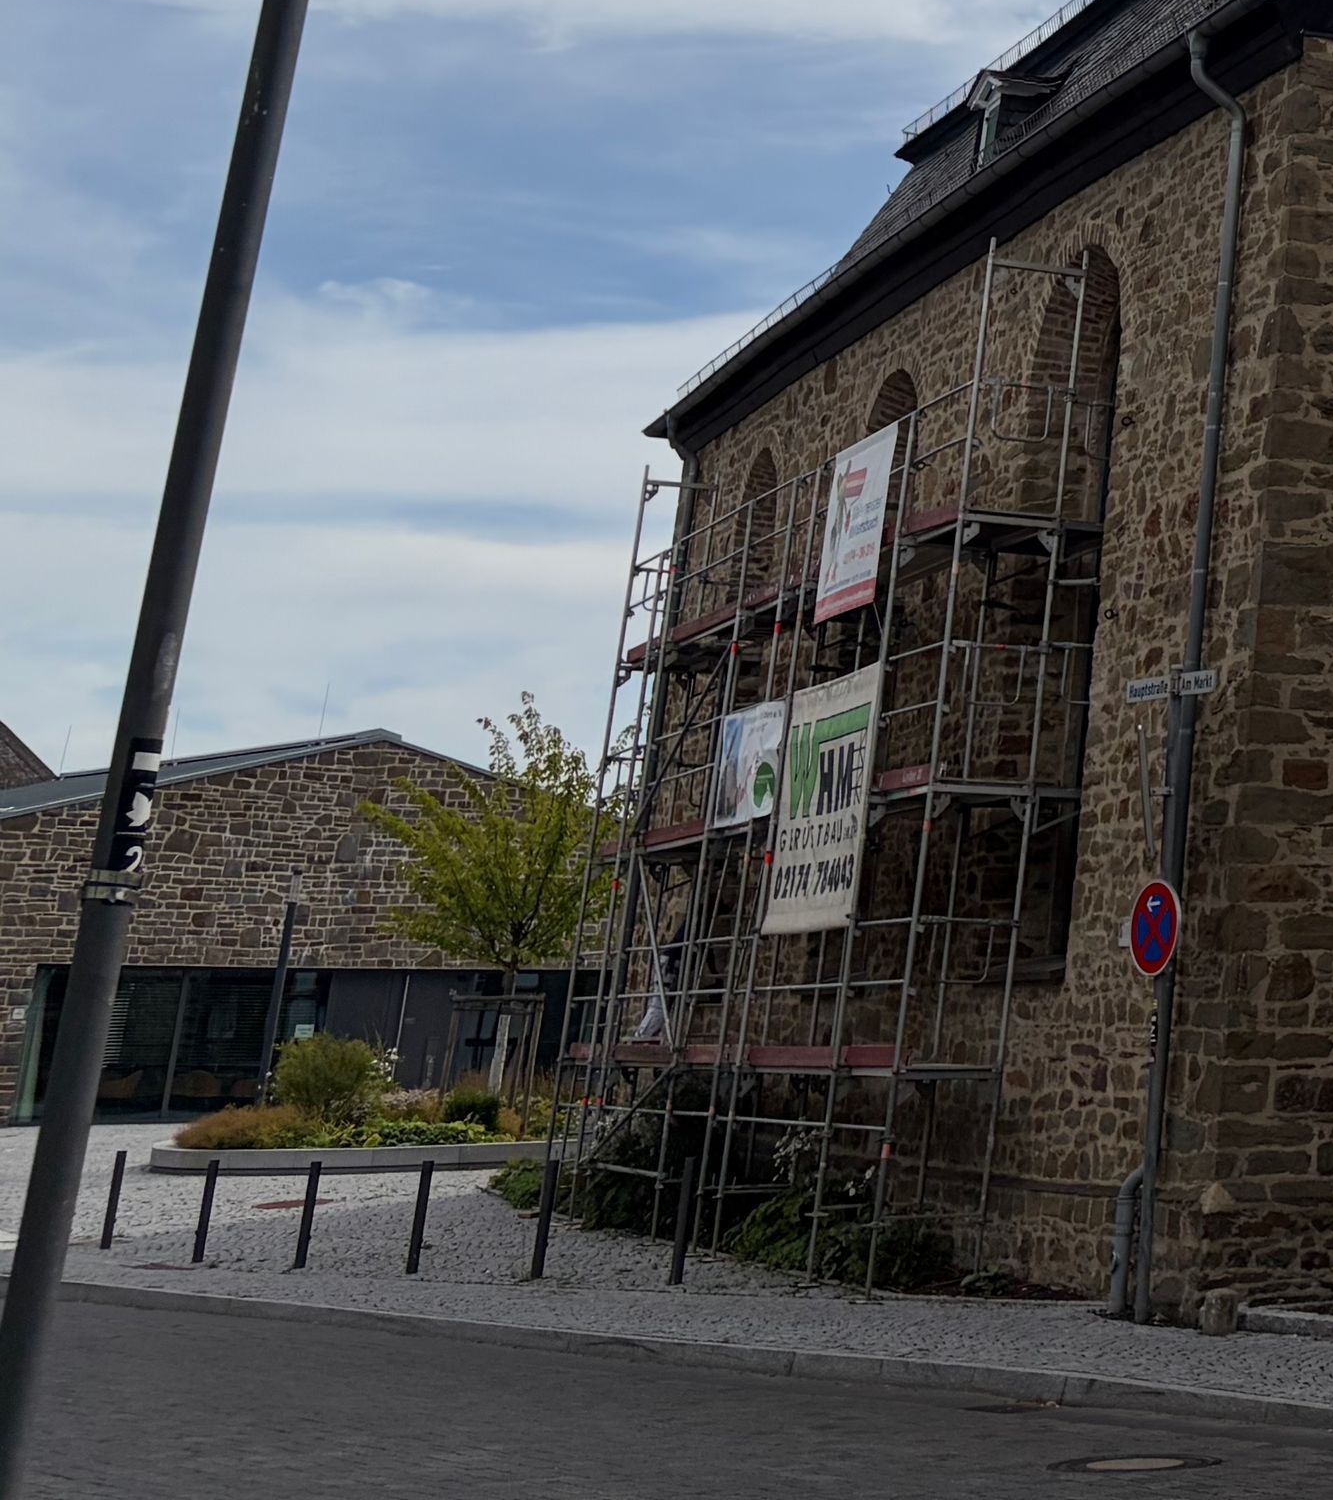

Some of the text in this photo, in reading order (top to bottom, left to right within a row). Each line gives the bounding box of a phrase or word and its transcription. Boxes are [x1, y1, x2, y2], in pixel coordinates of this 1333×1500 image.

[1129, 680, 1168, 700] Hauptstraße
[1194, 675, 1213, 690] Markt
[790, 702, 872, 820] WHM
